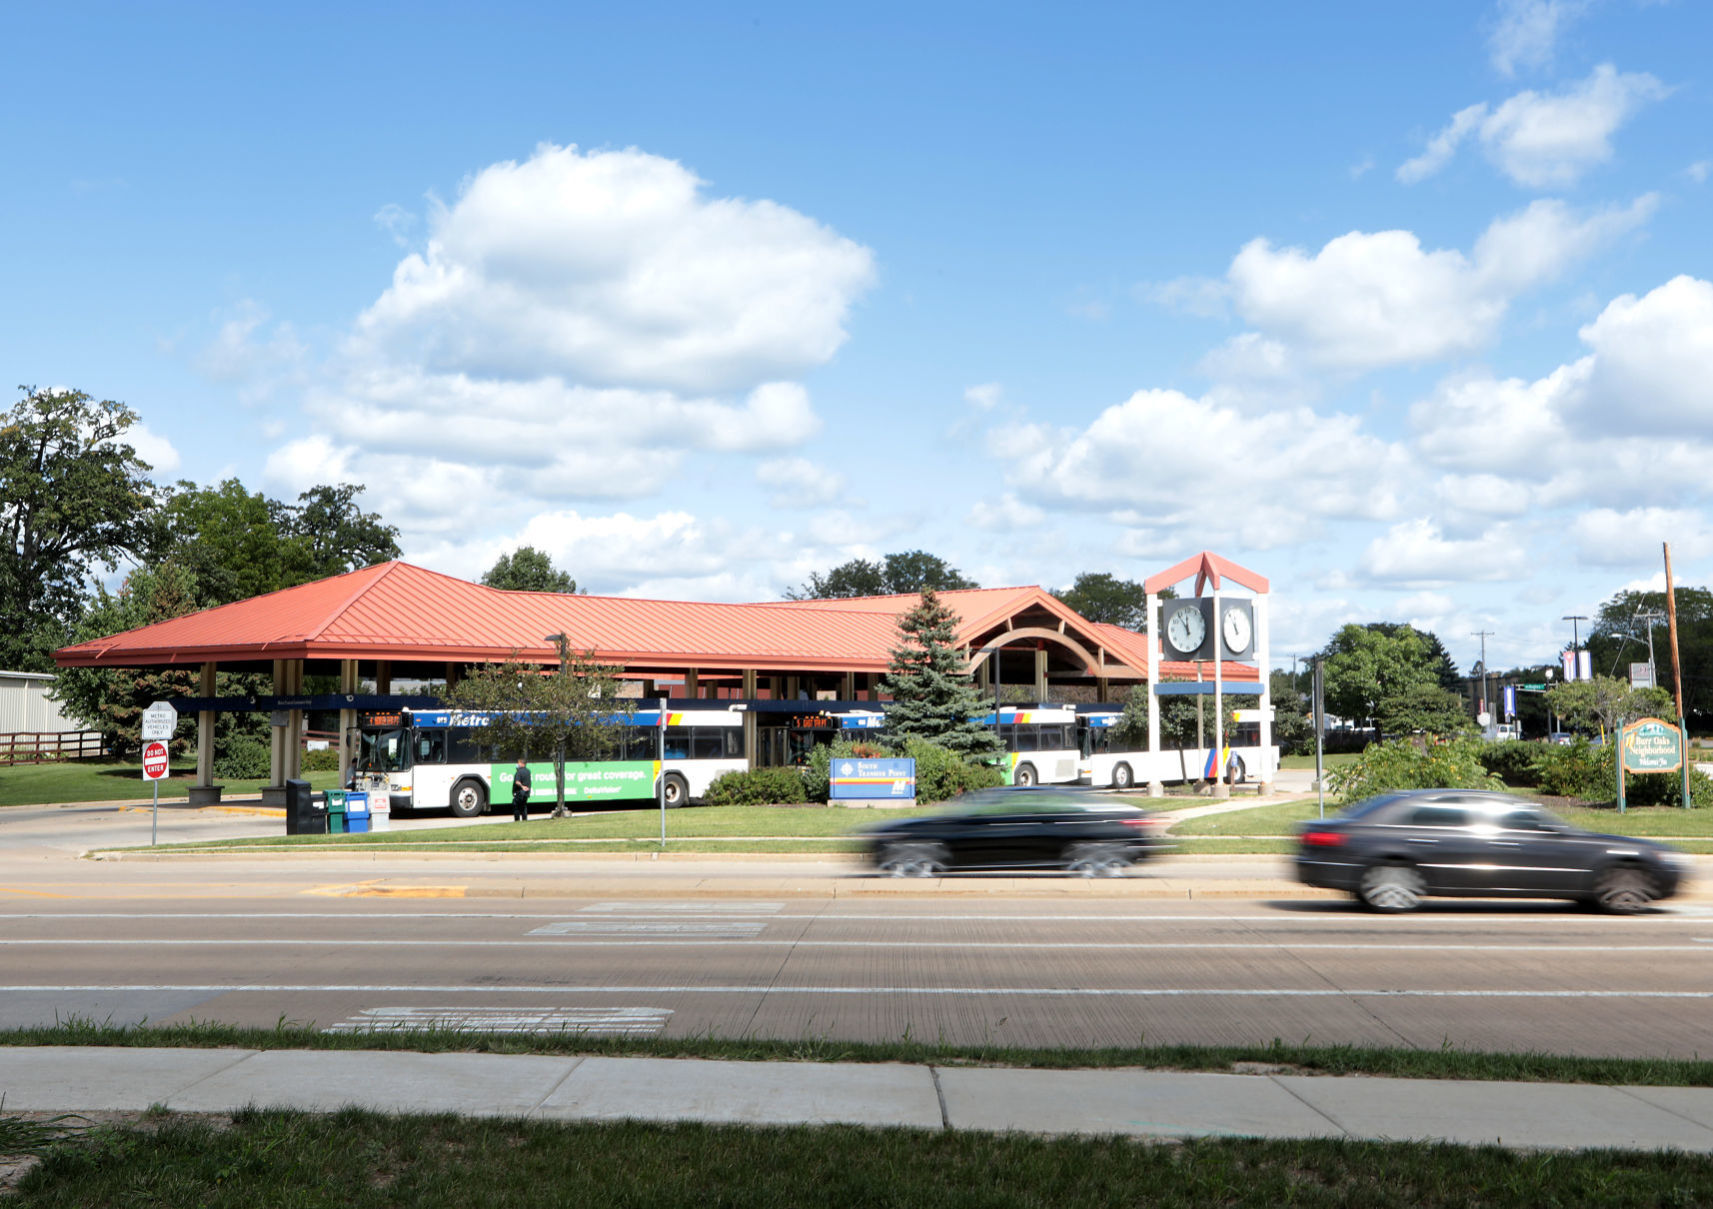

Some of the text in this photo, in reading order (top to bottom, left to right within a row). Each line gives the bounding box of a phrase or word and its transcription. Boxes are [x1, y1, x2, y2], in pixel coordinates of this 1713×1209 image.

[147, 749, 154, 757] DO
[148, 765, 164, 773] ENTER
[499, 772, 514, 783] Go
[535, 771, 557, 782] rout
[577, 770, 602, 783] great
[603, 770, 647, 782] coverage.
